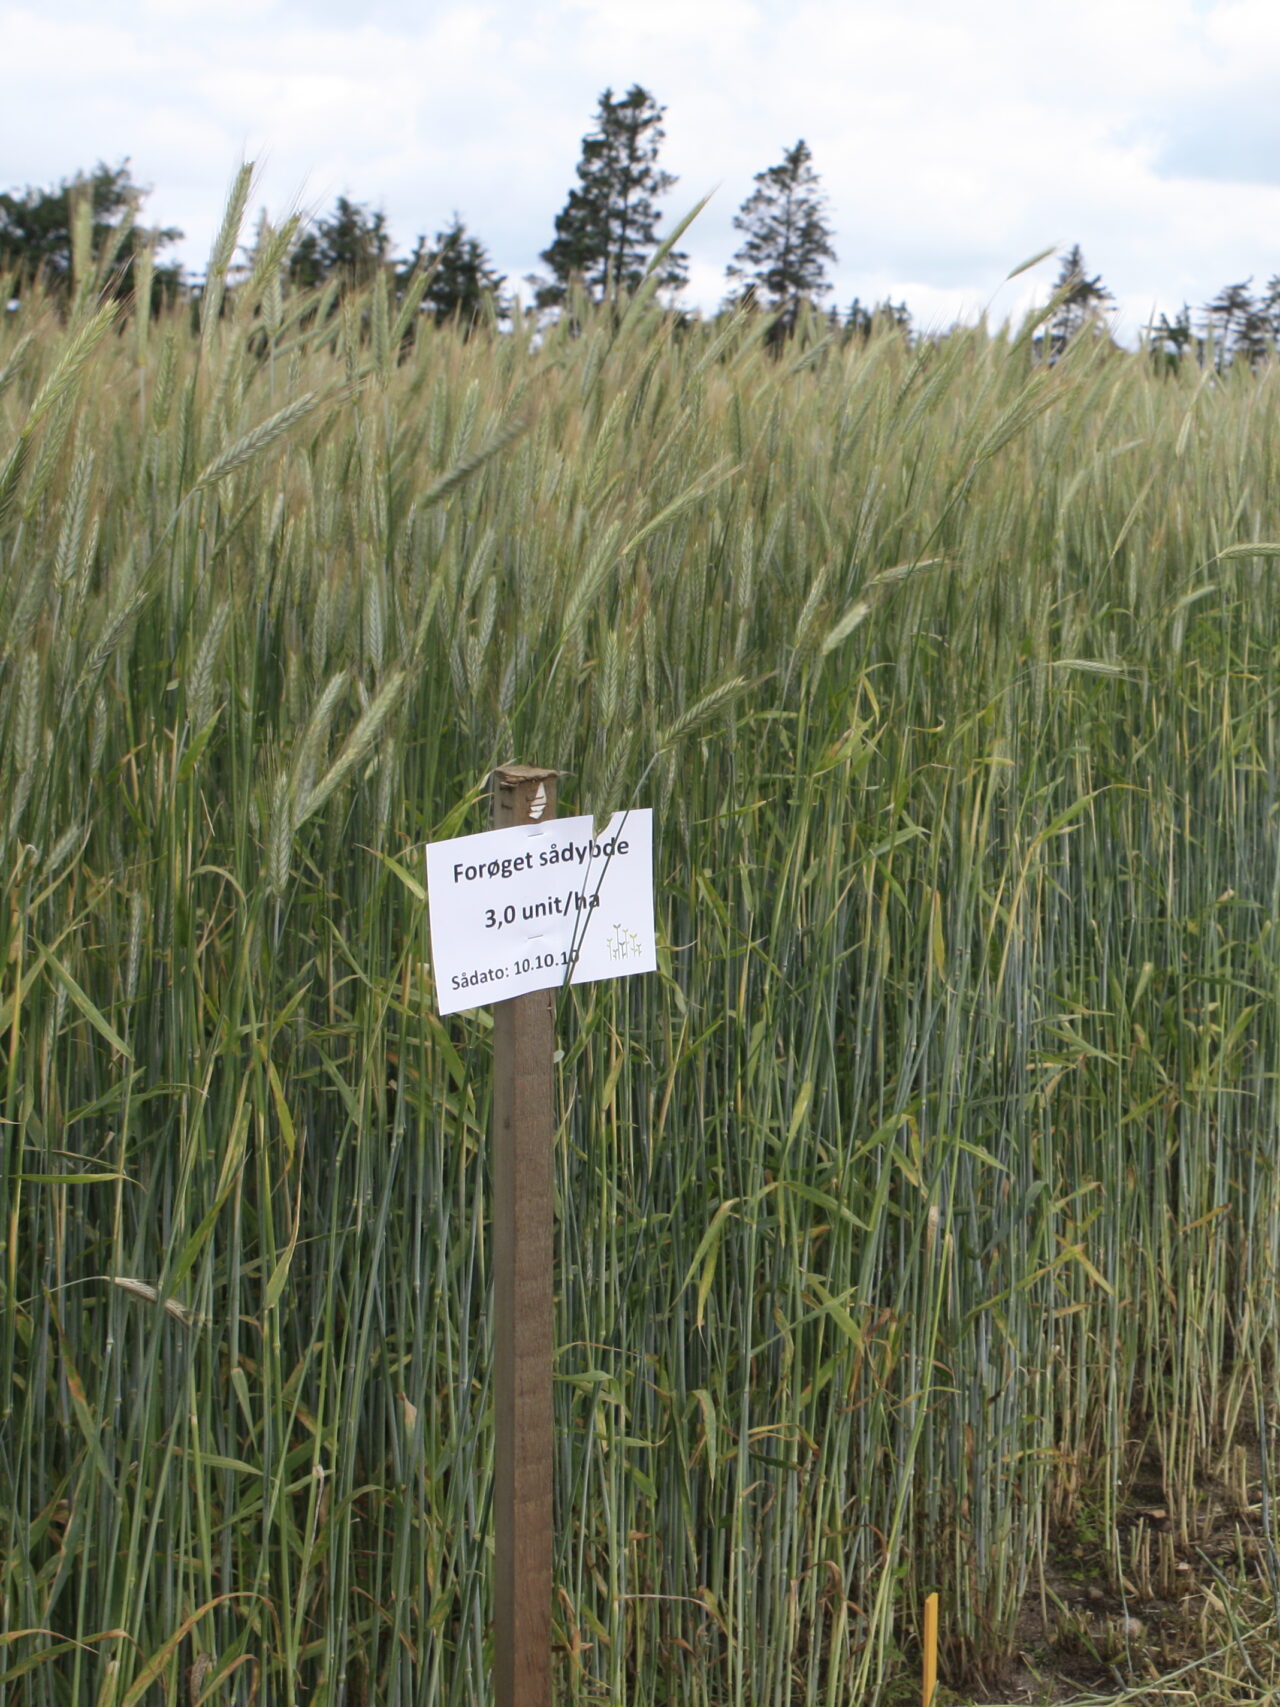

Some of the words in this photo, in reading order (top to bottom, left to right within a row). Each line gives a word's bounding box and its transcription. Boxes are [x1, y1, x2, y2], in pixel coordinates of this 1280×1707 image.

[454, 852, 533, 883] Forøget
[540, 837, 630, 866] sådybde
[485, 905, 516, 930] 3,0
[522, 891, 600, 920] unit/ha
[451, 967, 510, 990] Sådato:
